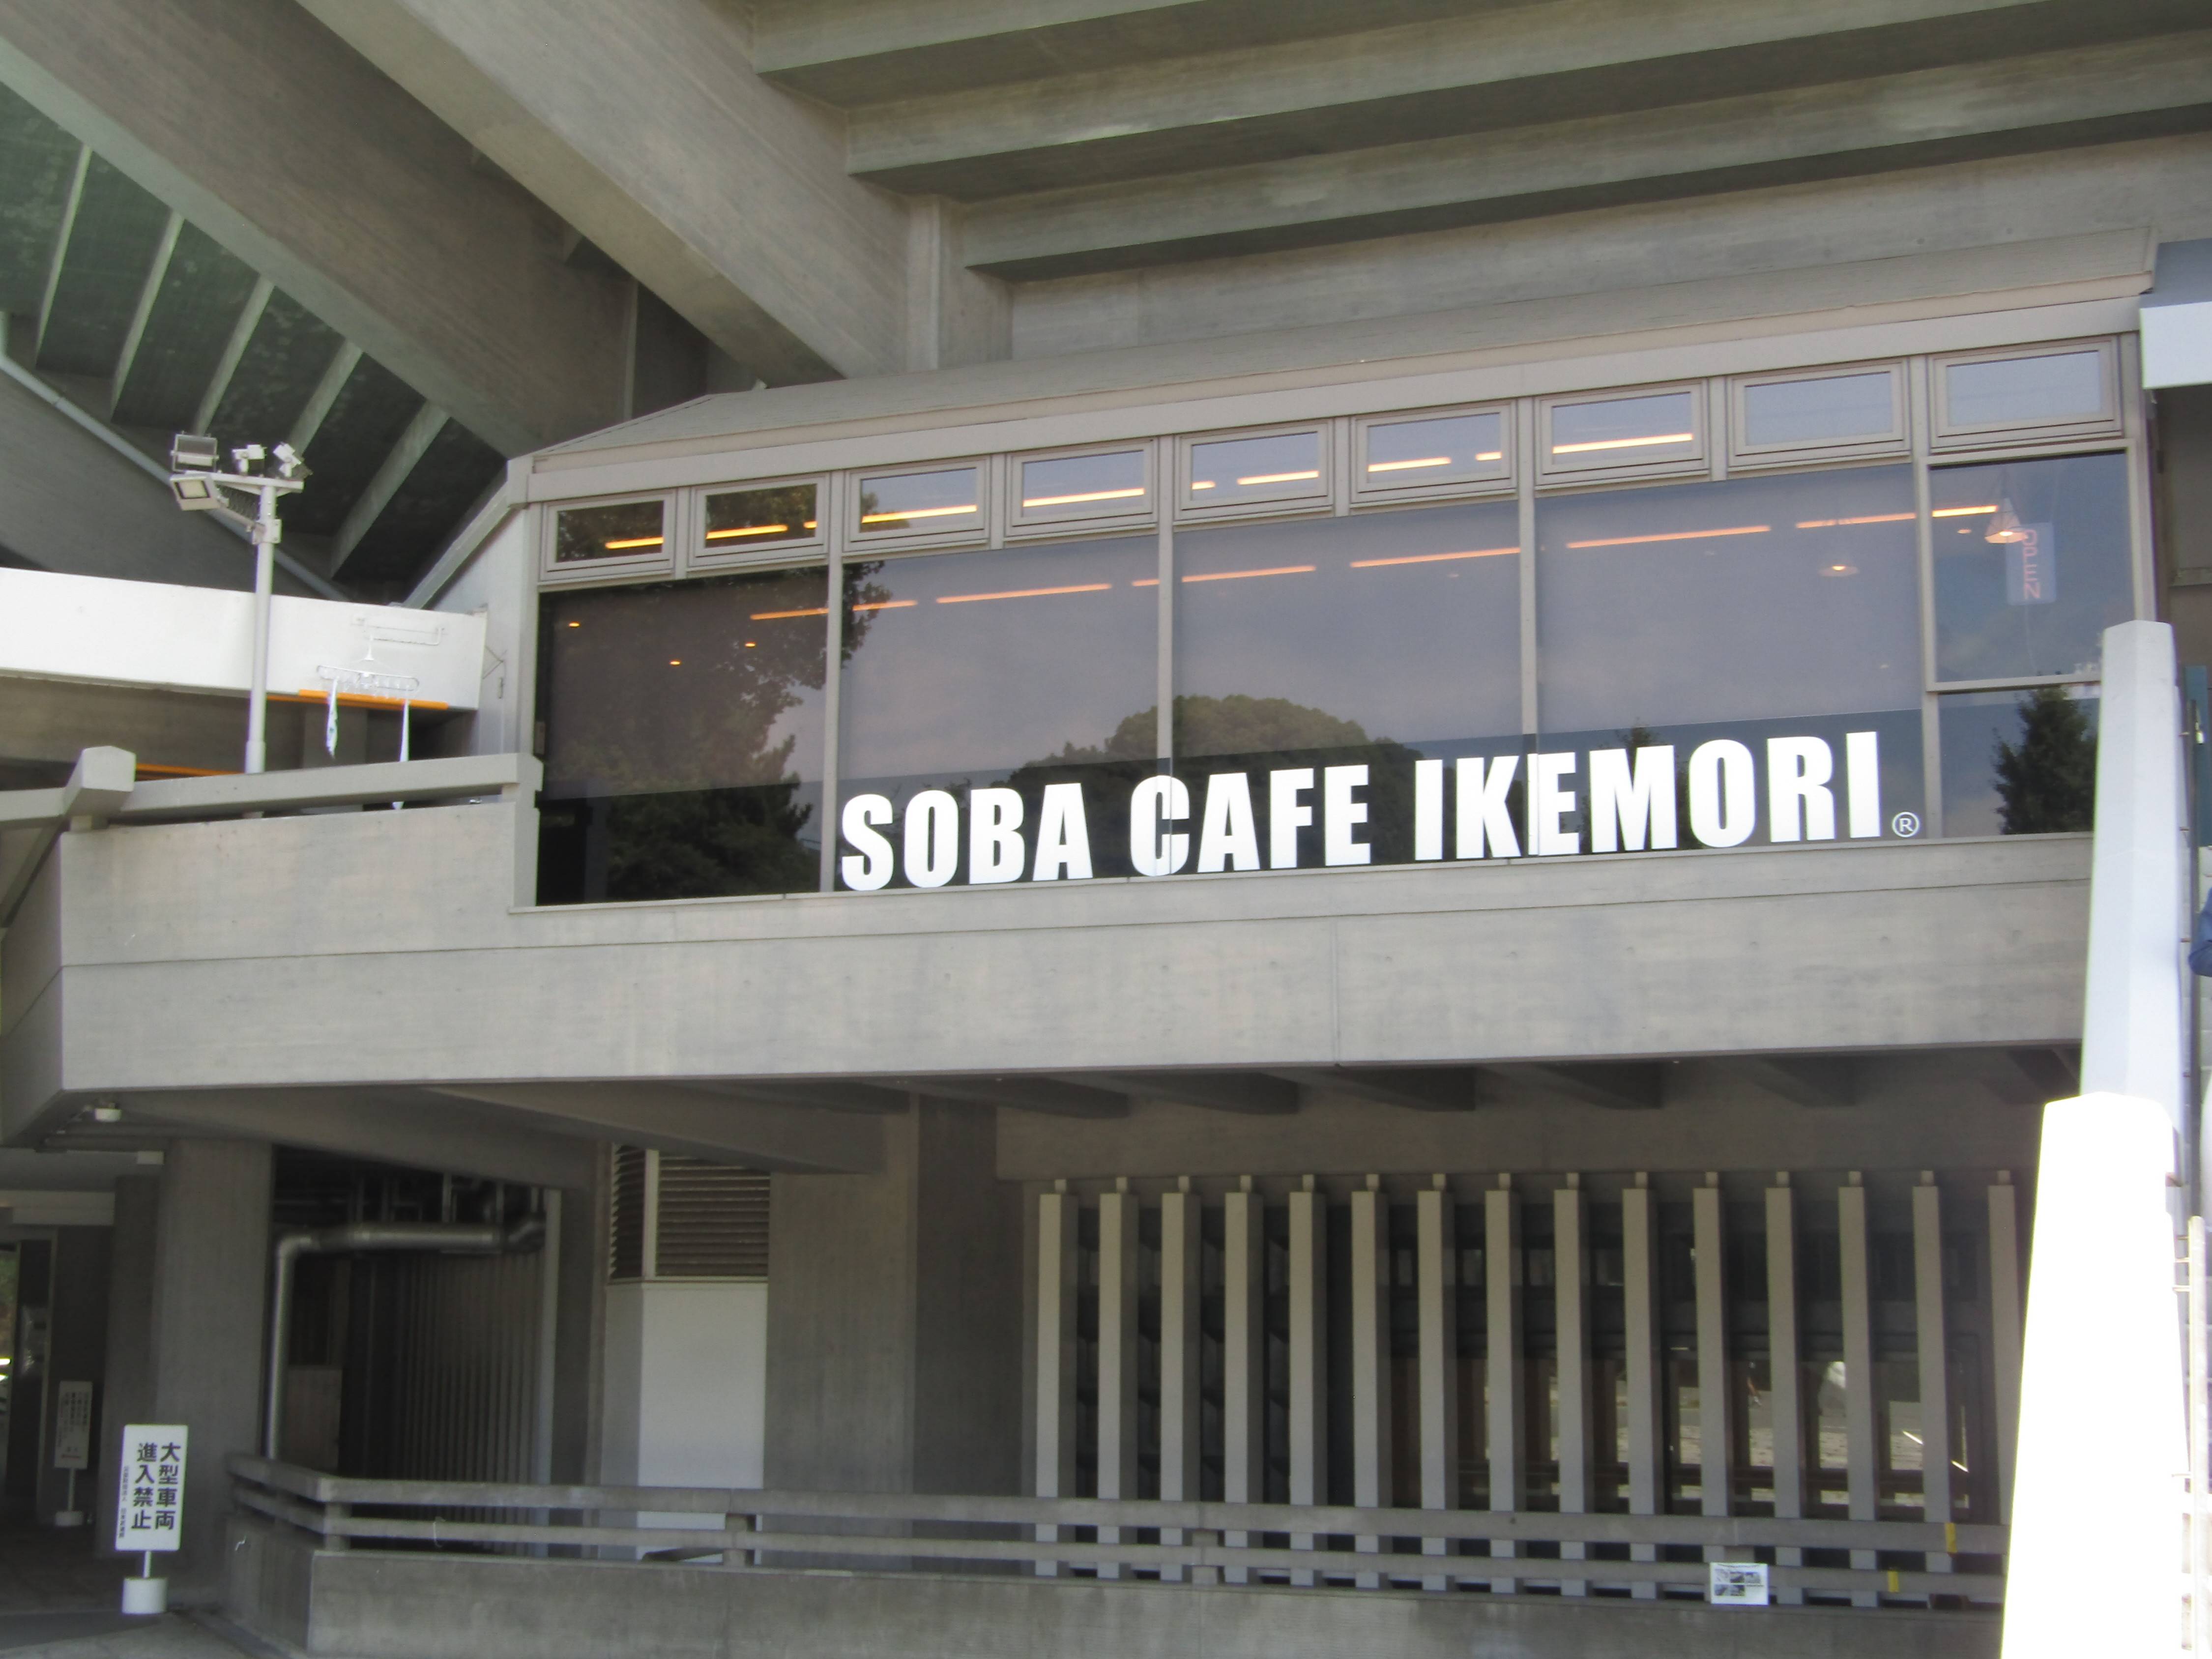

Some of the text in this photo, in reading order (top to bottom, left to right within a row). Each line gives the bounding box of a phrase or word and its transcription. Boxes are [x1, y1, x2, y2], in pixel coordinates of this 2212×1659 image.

[2022, 529, 2040, 601] OPEN
[842, 783, 1093, 891] SOBA
[1130, 764, 1370, 877] CAFE
[131, 1442, 158, 1530] 進入禁止
[155, 1441, 181, 1531] 大型車両
